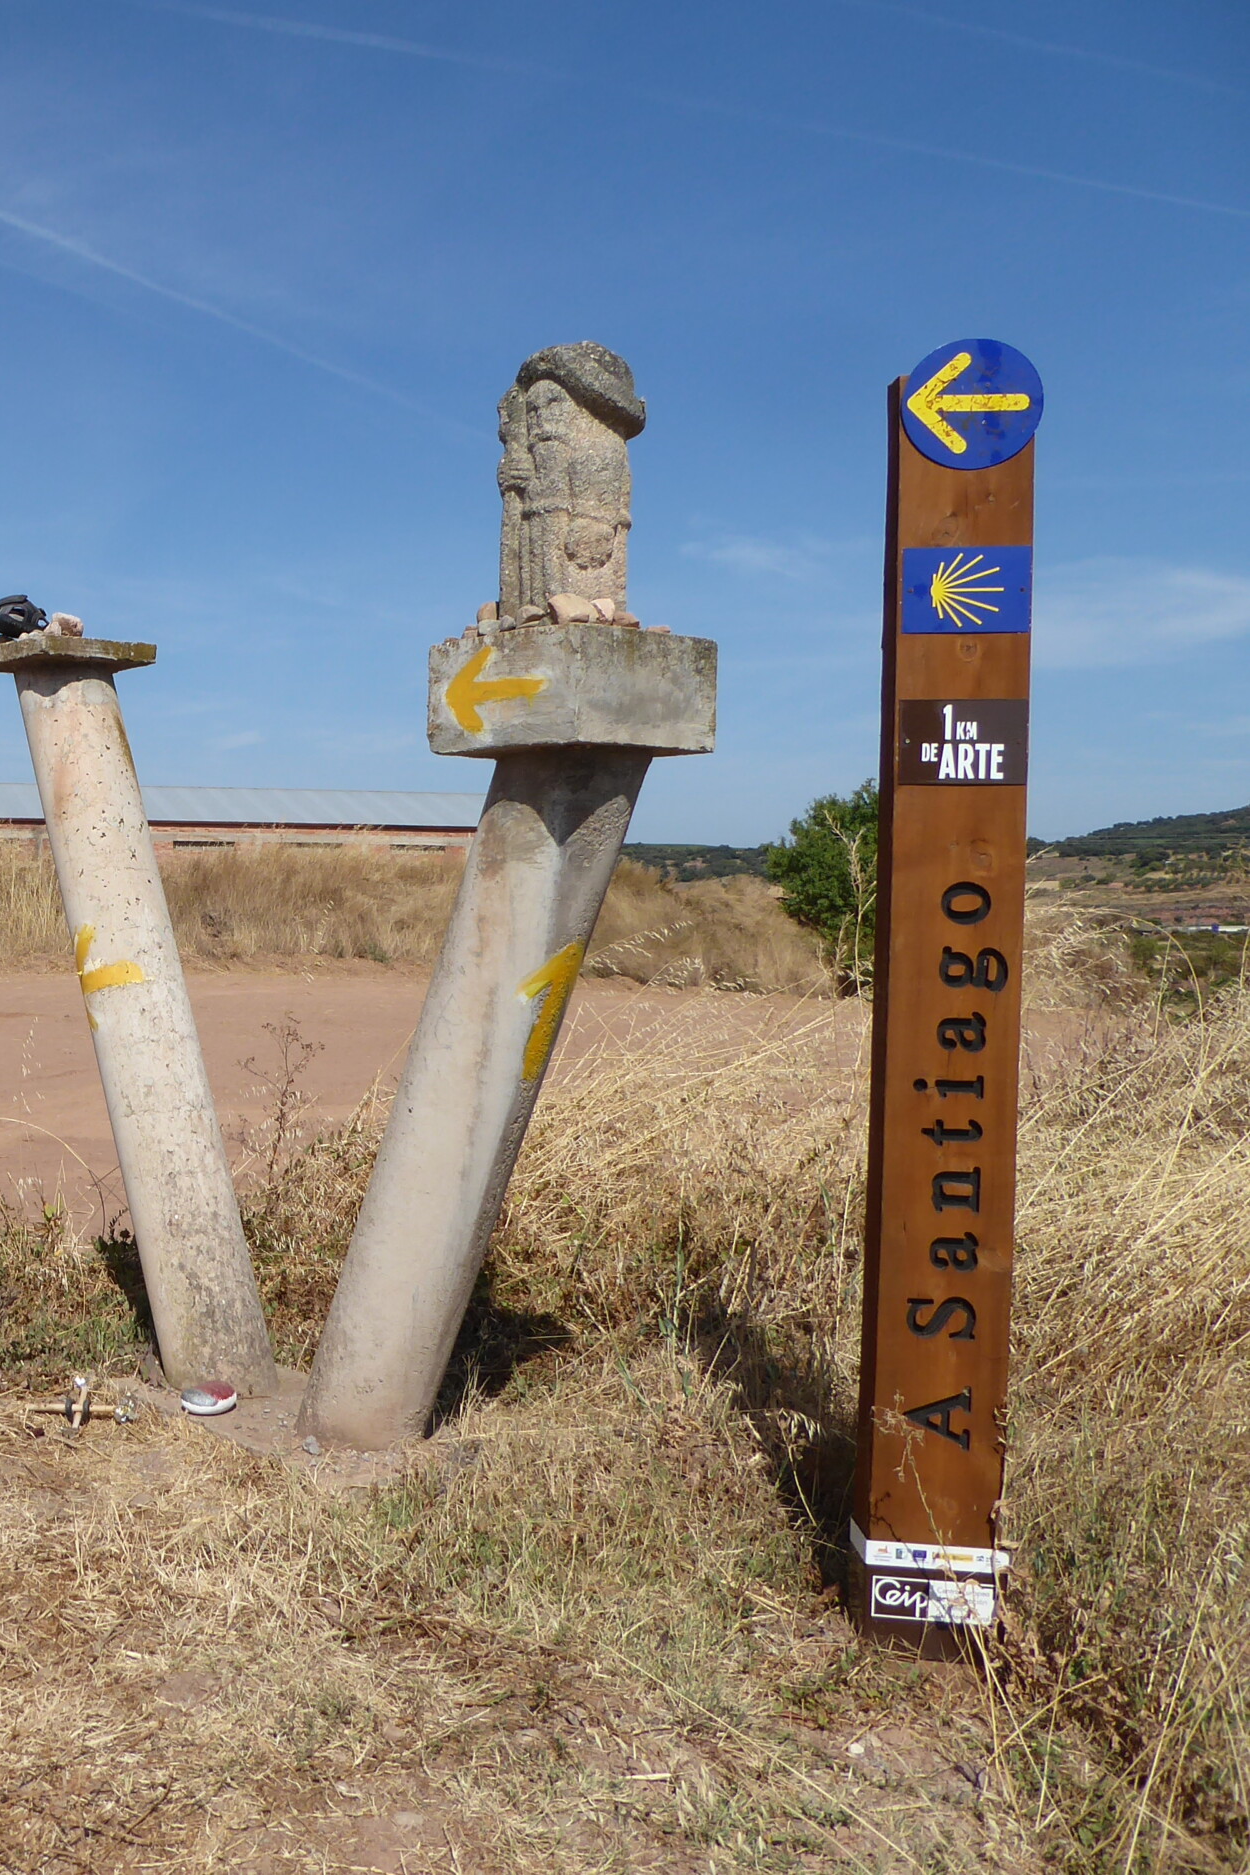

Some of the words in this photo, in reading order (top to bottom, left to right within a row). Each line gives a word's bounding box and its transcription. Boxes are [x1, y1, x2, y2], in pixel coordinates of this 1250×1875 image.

[943, 704, 953, 740] 1
[956, 721, 978, 740] KM
[921, 743, 939, 762] DE
[938, 743, 1005, 780] ARTE
[906, 880, 1010, 1342] Santiago
[904, 1386, 973, 1452] A
